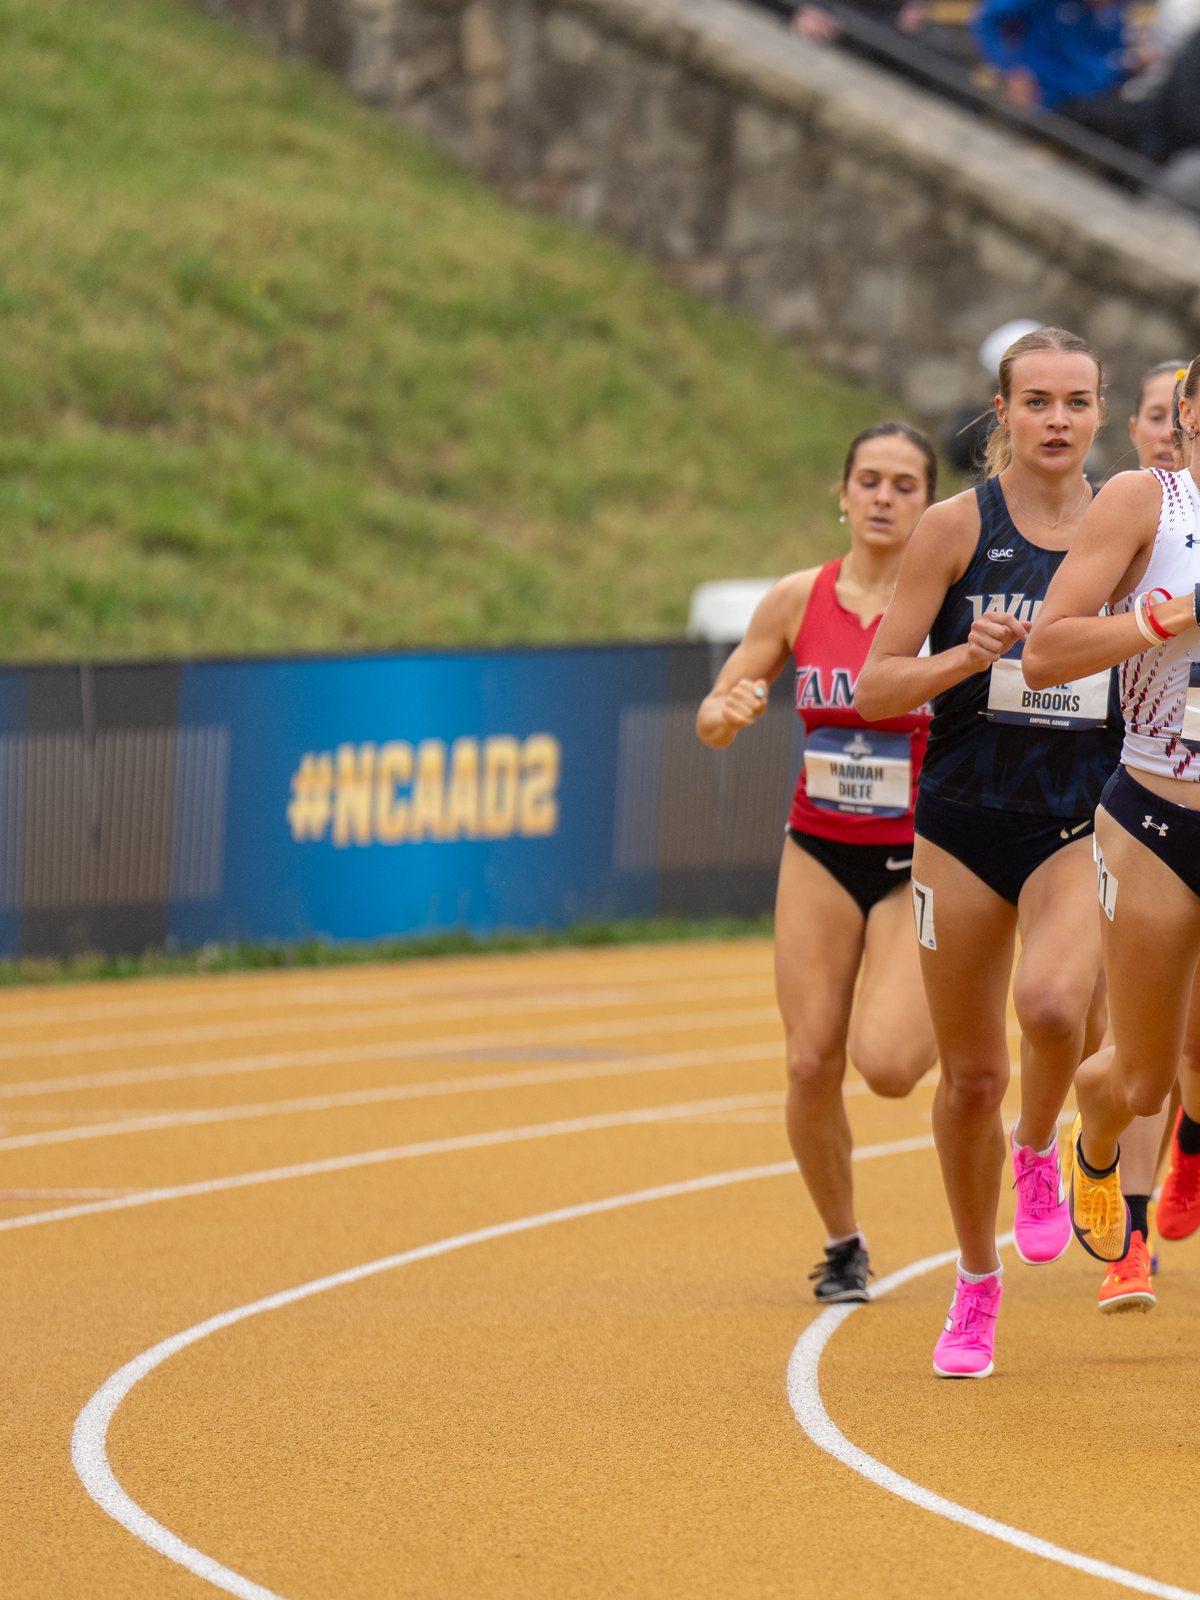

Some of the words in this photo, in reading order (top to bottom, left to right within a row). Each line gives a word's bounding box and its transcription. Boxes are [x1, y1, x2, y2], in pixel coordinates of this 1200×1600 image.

[990, 548, 1014, 558] SAC
[1021, 691, 1080, 712] BROOKS
[830, 763, 884, 781] HANNAH
[288, 733, 561, 848] #NCAAD2
[839, 783, 873, 800] DIETE
[914, 886, 926, 940] 7
